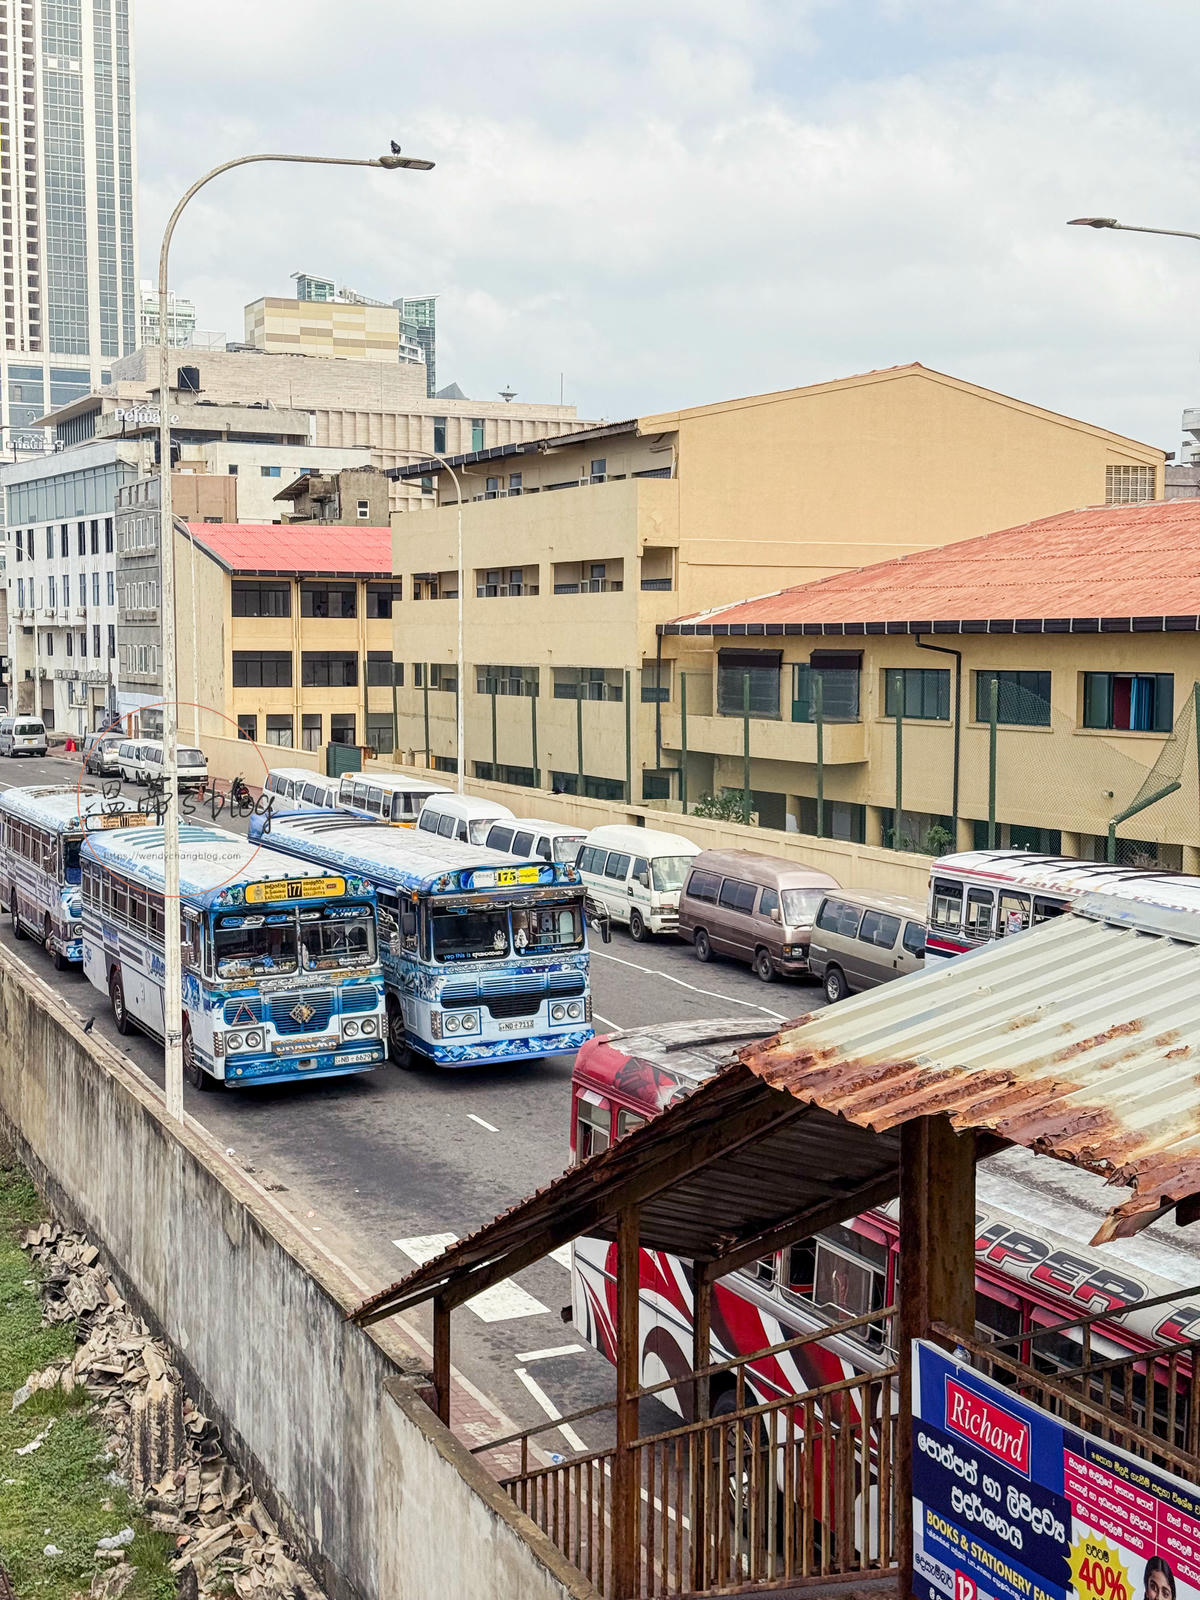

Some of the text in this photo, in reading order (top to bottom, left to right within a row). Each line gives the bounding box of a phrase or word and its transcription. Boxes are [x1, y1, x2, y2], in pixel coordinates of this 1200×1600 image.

[115, 407, 179, 425] Pelwae
[287, 884, 301, 898] 177
[497, 871, 516, 882] 175
[975, 1214, 1146, 1317] UPER
[950, 1391, 1024, 1463] Richard
[926, 1509, 959, 1544] BOOKS
[960, 1536, 969, 1552] &
[971, 1542, 1032, 1596] STATIONERY
[957, 1576, 974, 1600] 12
[1079, 1558, 1127, 1600] 40%
